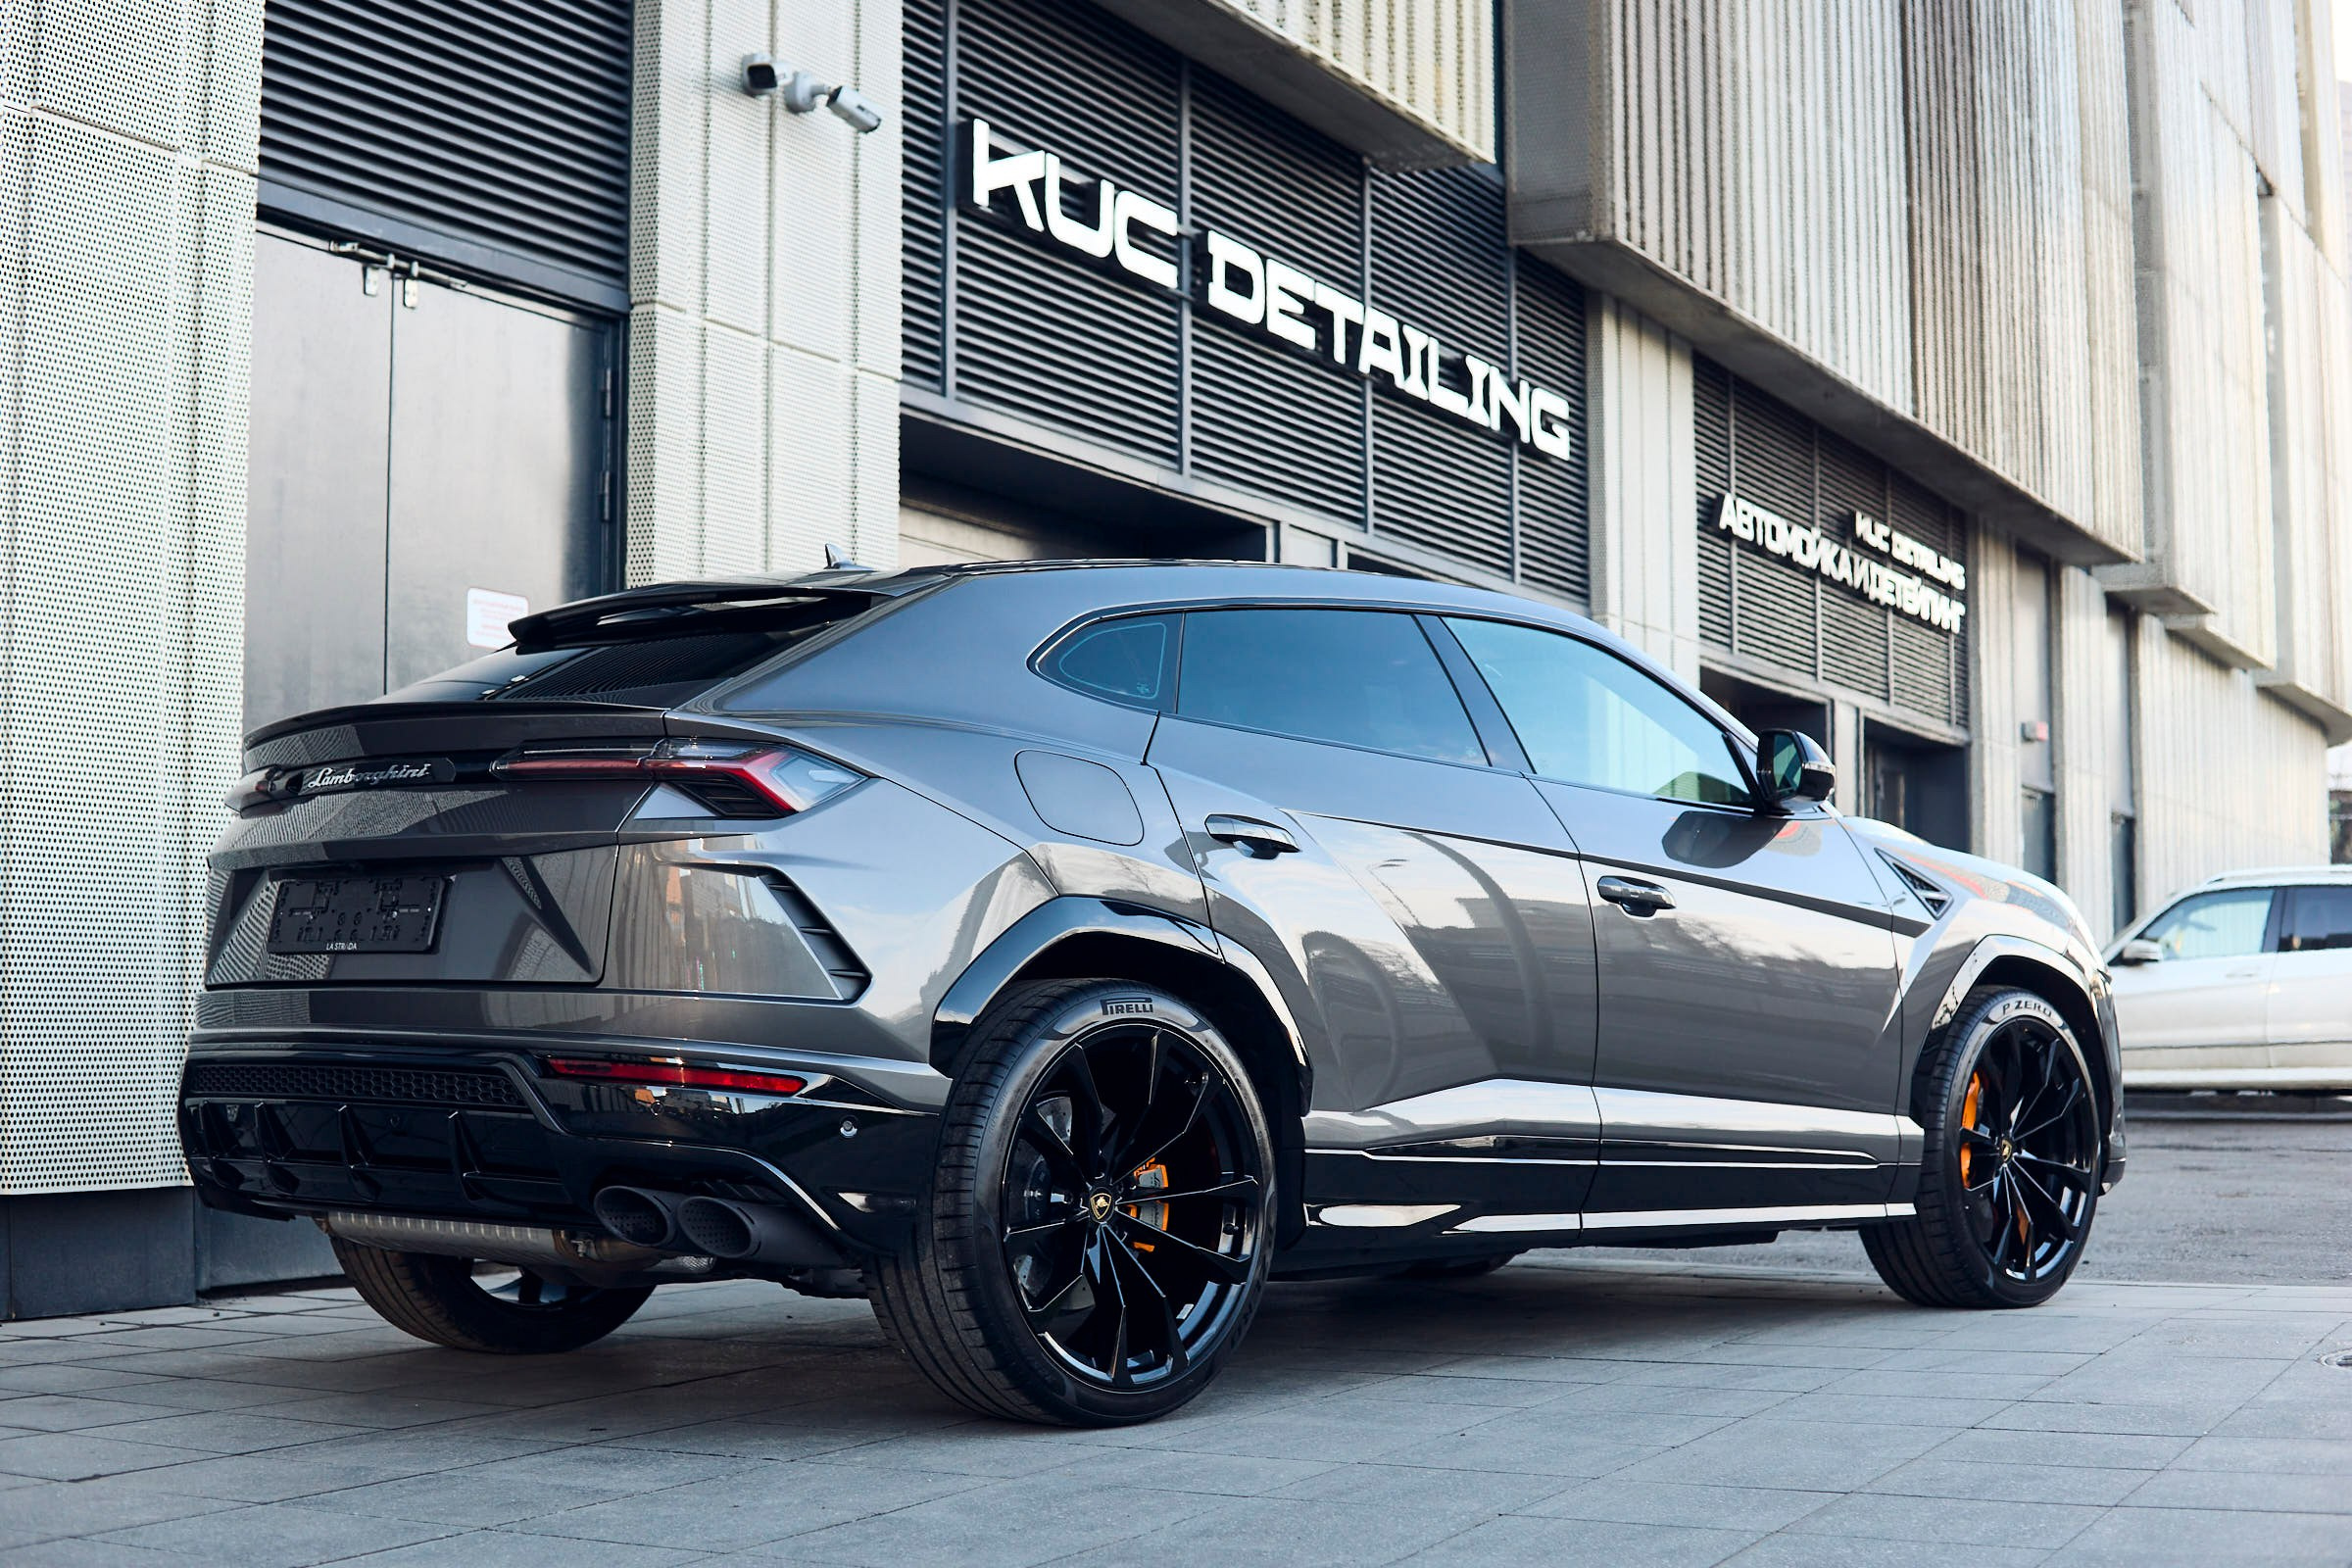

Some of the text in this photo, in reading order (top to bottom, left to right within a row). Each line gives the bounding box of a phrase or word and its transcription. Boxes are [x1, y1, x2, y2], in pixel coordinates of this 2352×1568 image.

[973, 119, 1570, 462] KUC DETAILING
[1719, 492, 1854, 587] АВТОМОЙКА
[1868, 561, 1966, 635] ДЕТЕЙЛИНГ
[308, 763, 432, 788] Lamborghini
[1100, 997, 1153, 1016] PIRELLI
[2002, 1000, 2052, 1017] P ZERO
